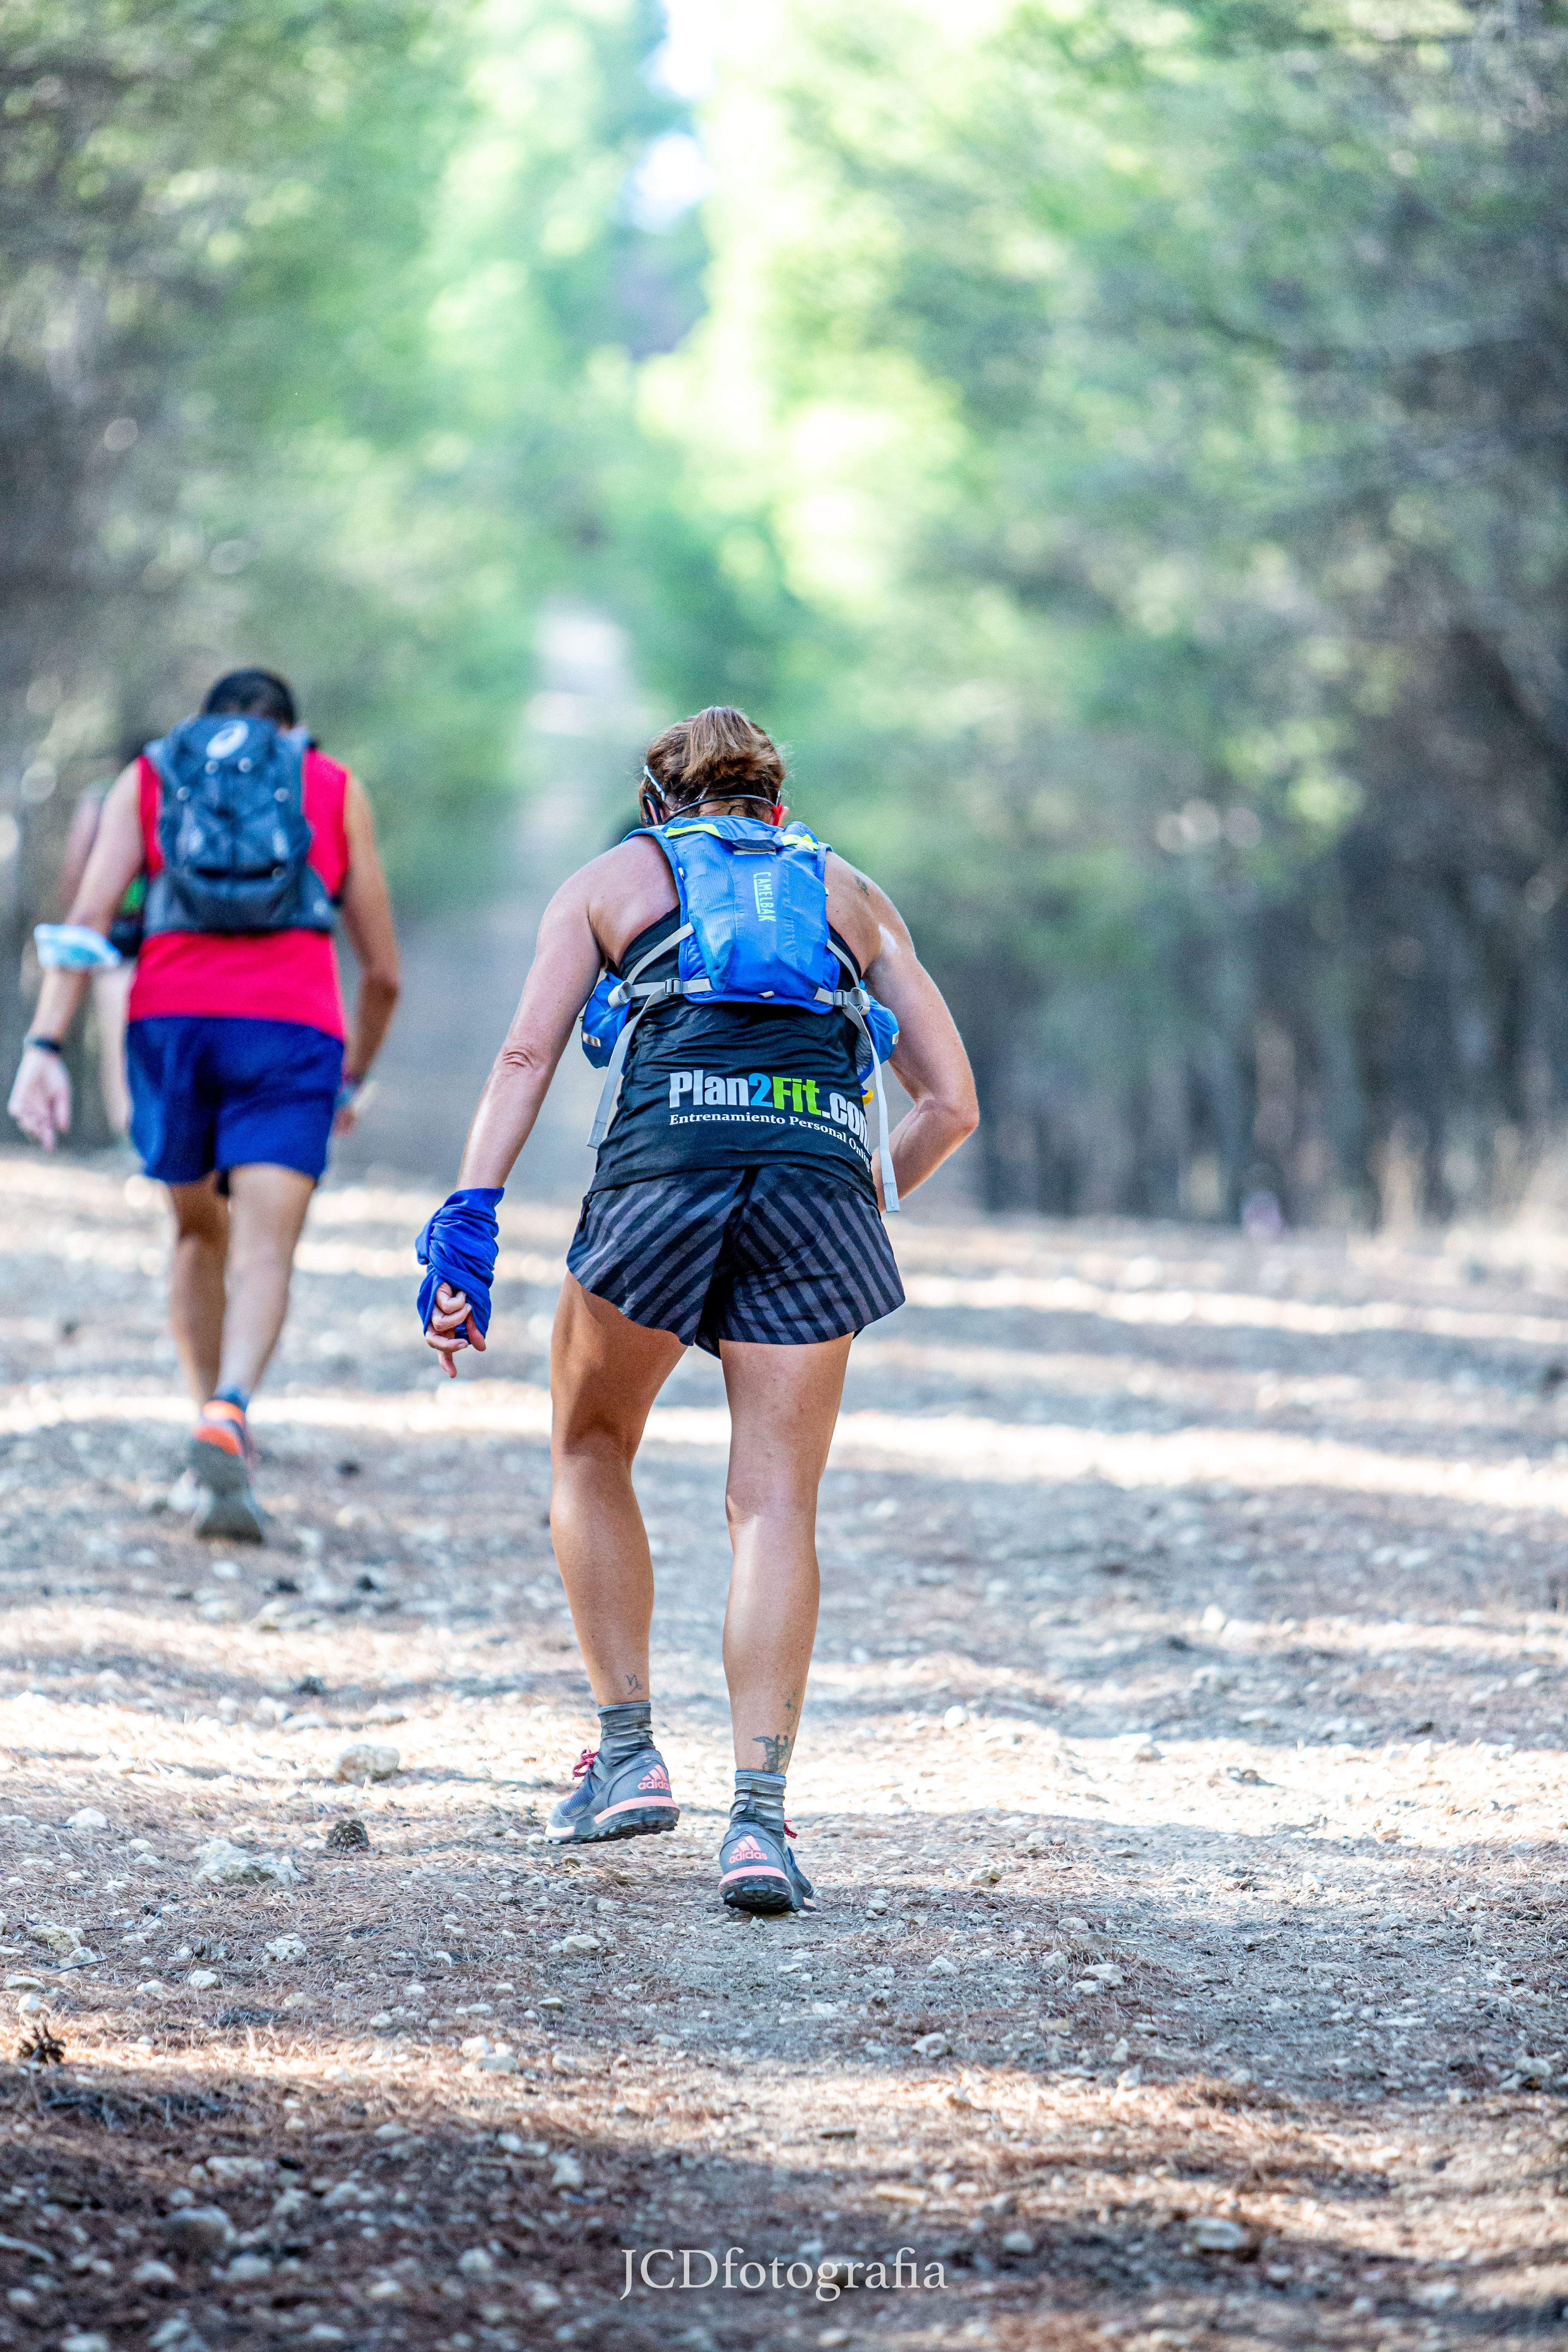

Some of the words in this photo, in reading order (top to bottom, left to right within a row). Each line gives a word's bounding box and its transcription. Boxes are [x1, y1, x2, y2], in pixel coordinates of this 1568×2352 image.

[753, 871, 776, 922] CAMELBAK
[669, 1069, 871, 1156] Plan2Fit.com
[669, 1112, 785, 1125] Entrenamiento
[789, 1116, 846, 1143] Personal
[637, 1778, 670, 1791] adida
[729, 1849, 768, 1864] adidas
